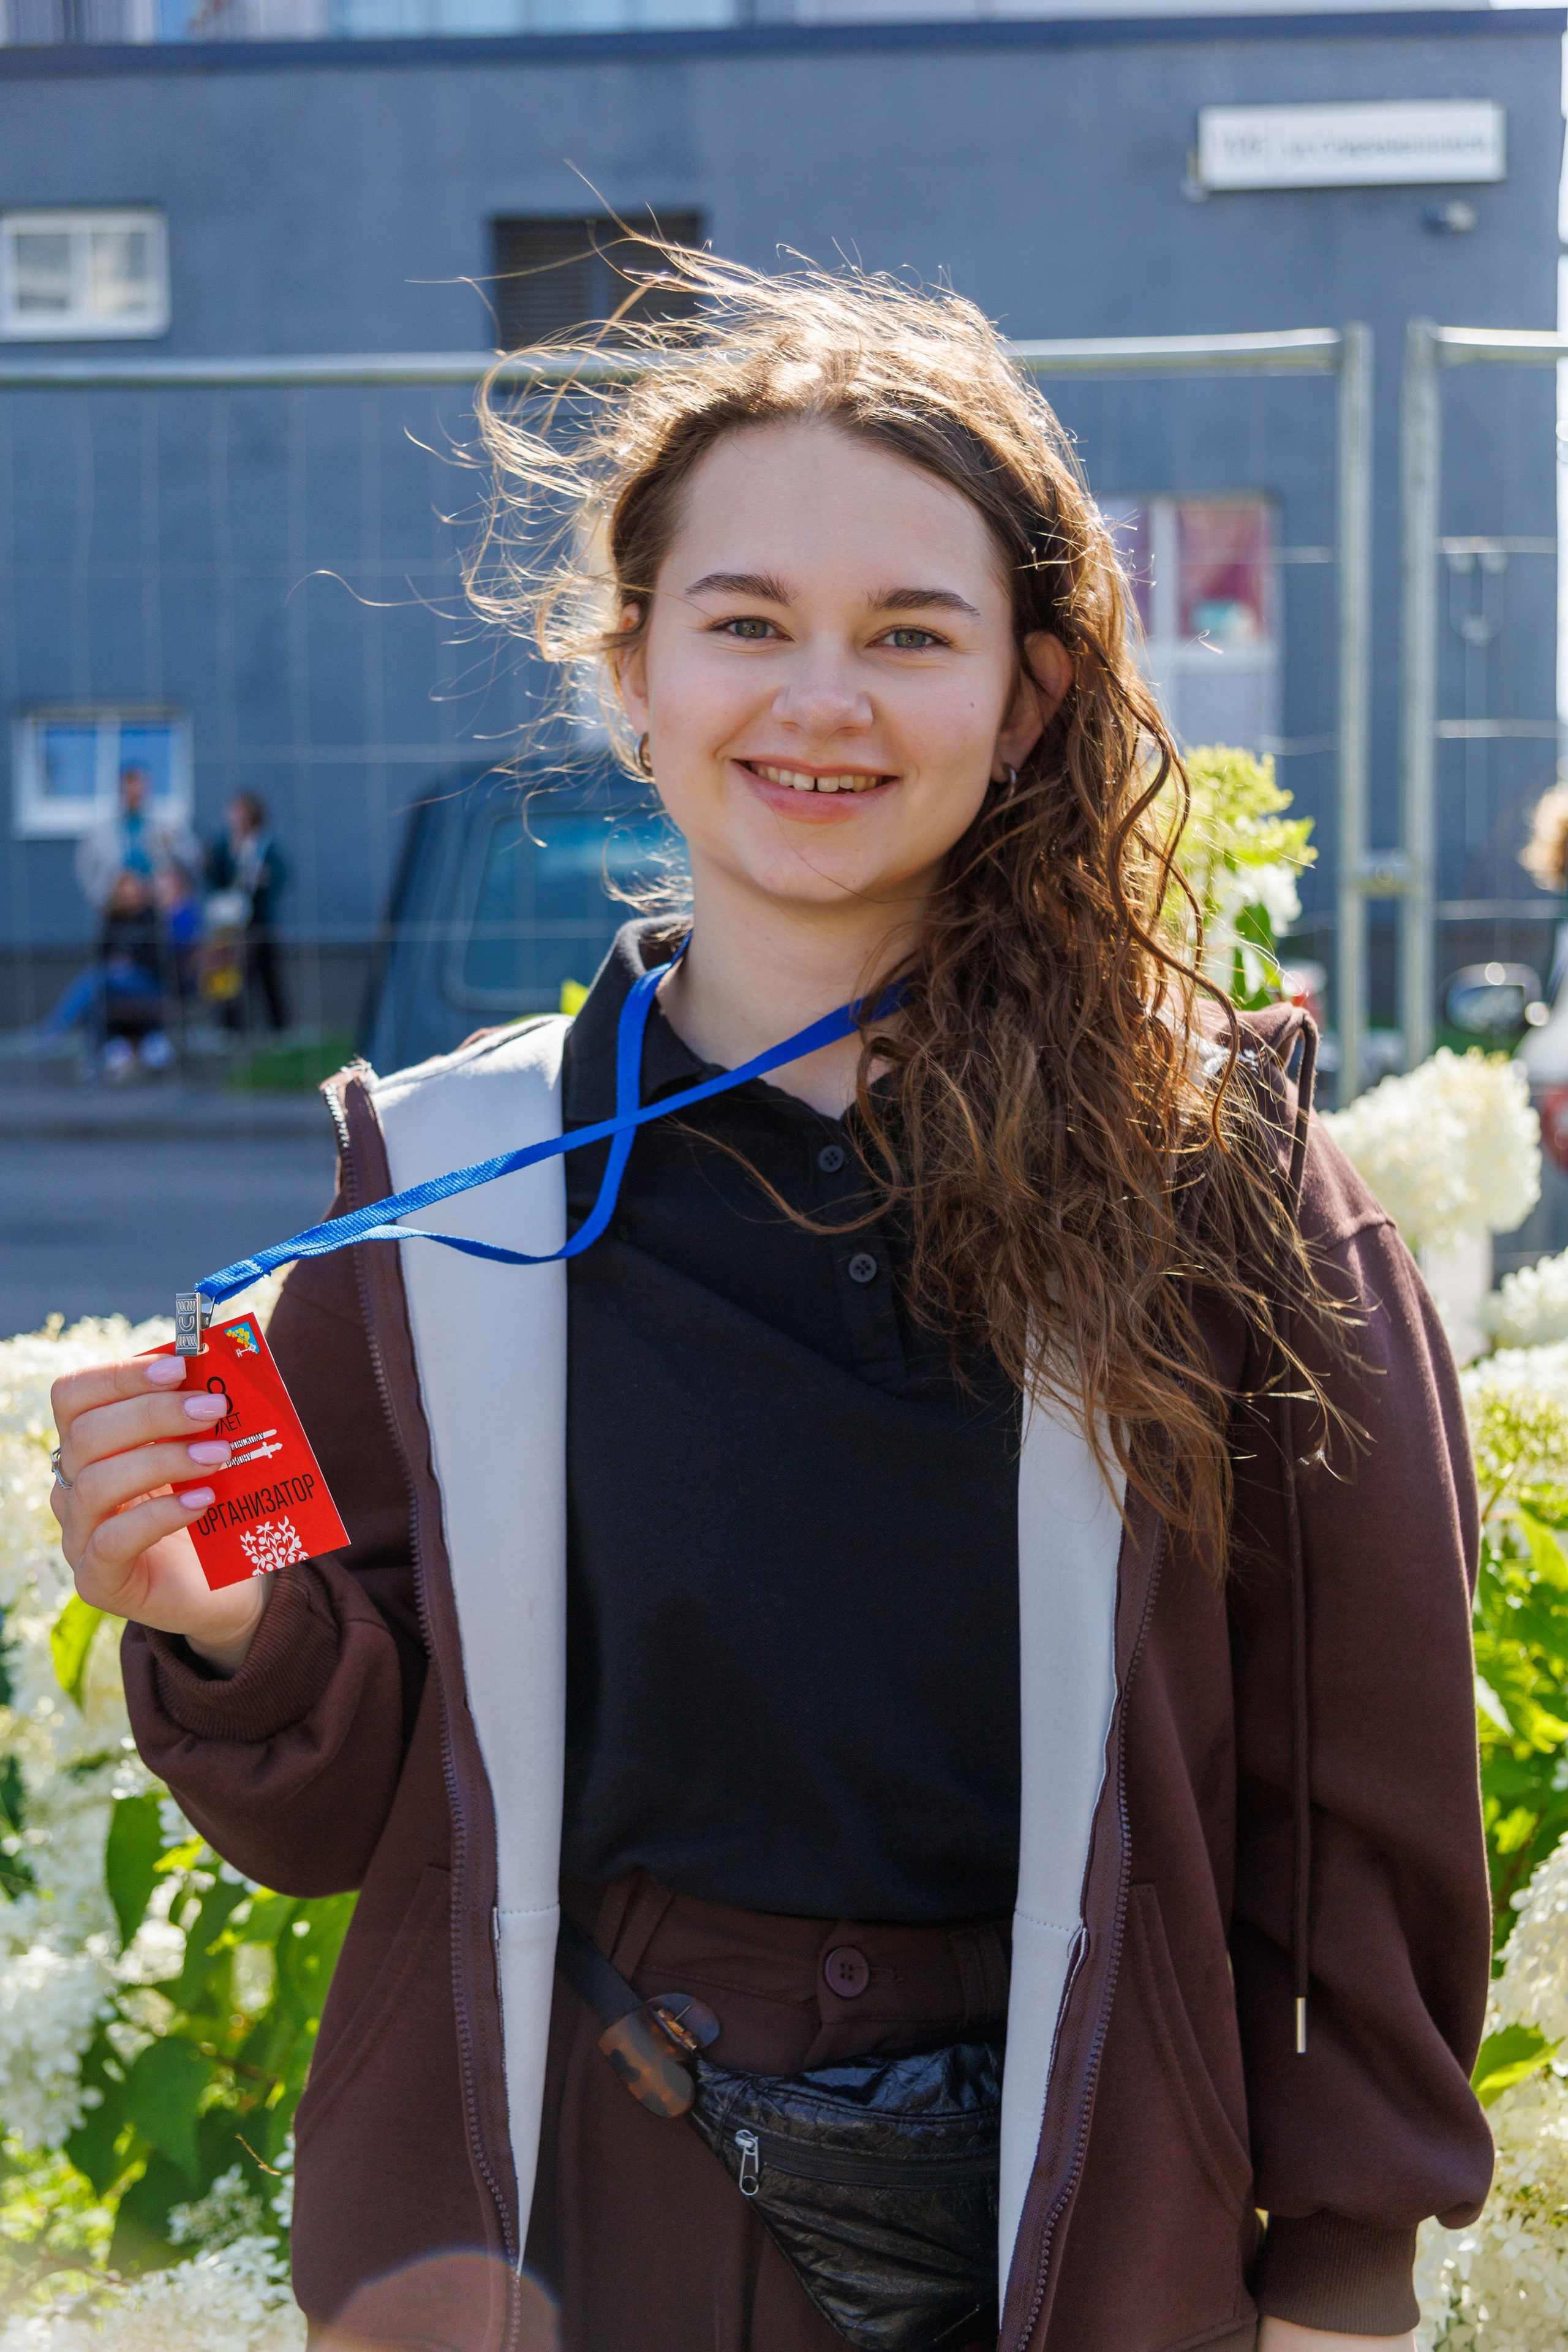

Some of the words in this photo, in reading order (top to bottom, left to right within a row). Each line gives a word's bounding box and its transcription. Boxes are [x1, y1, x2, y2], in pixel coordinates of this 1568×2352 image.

[220, 1412, 240, 1434] ЛЕТ
[229, 1431, 264, 1451] СОВСКОМУ
[226, 1452, 252, 1469] РАЙОНУ
[197, 1474, 314, 1536] ОРГАНИЗАТОР
